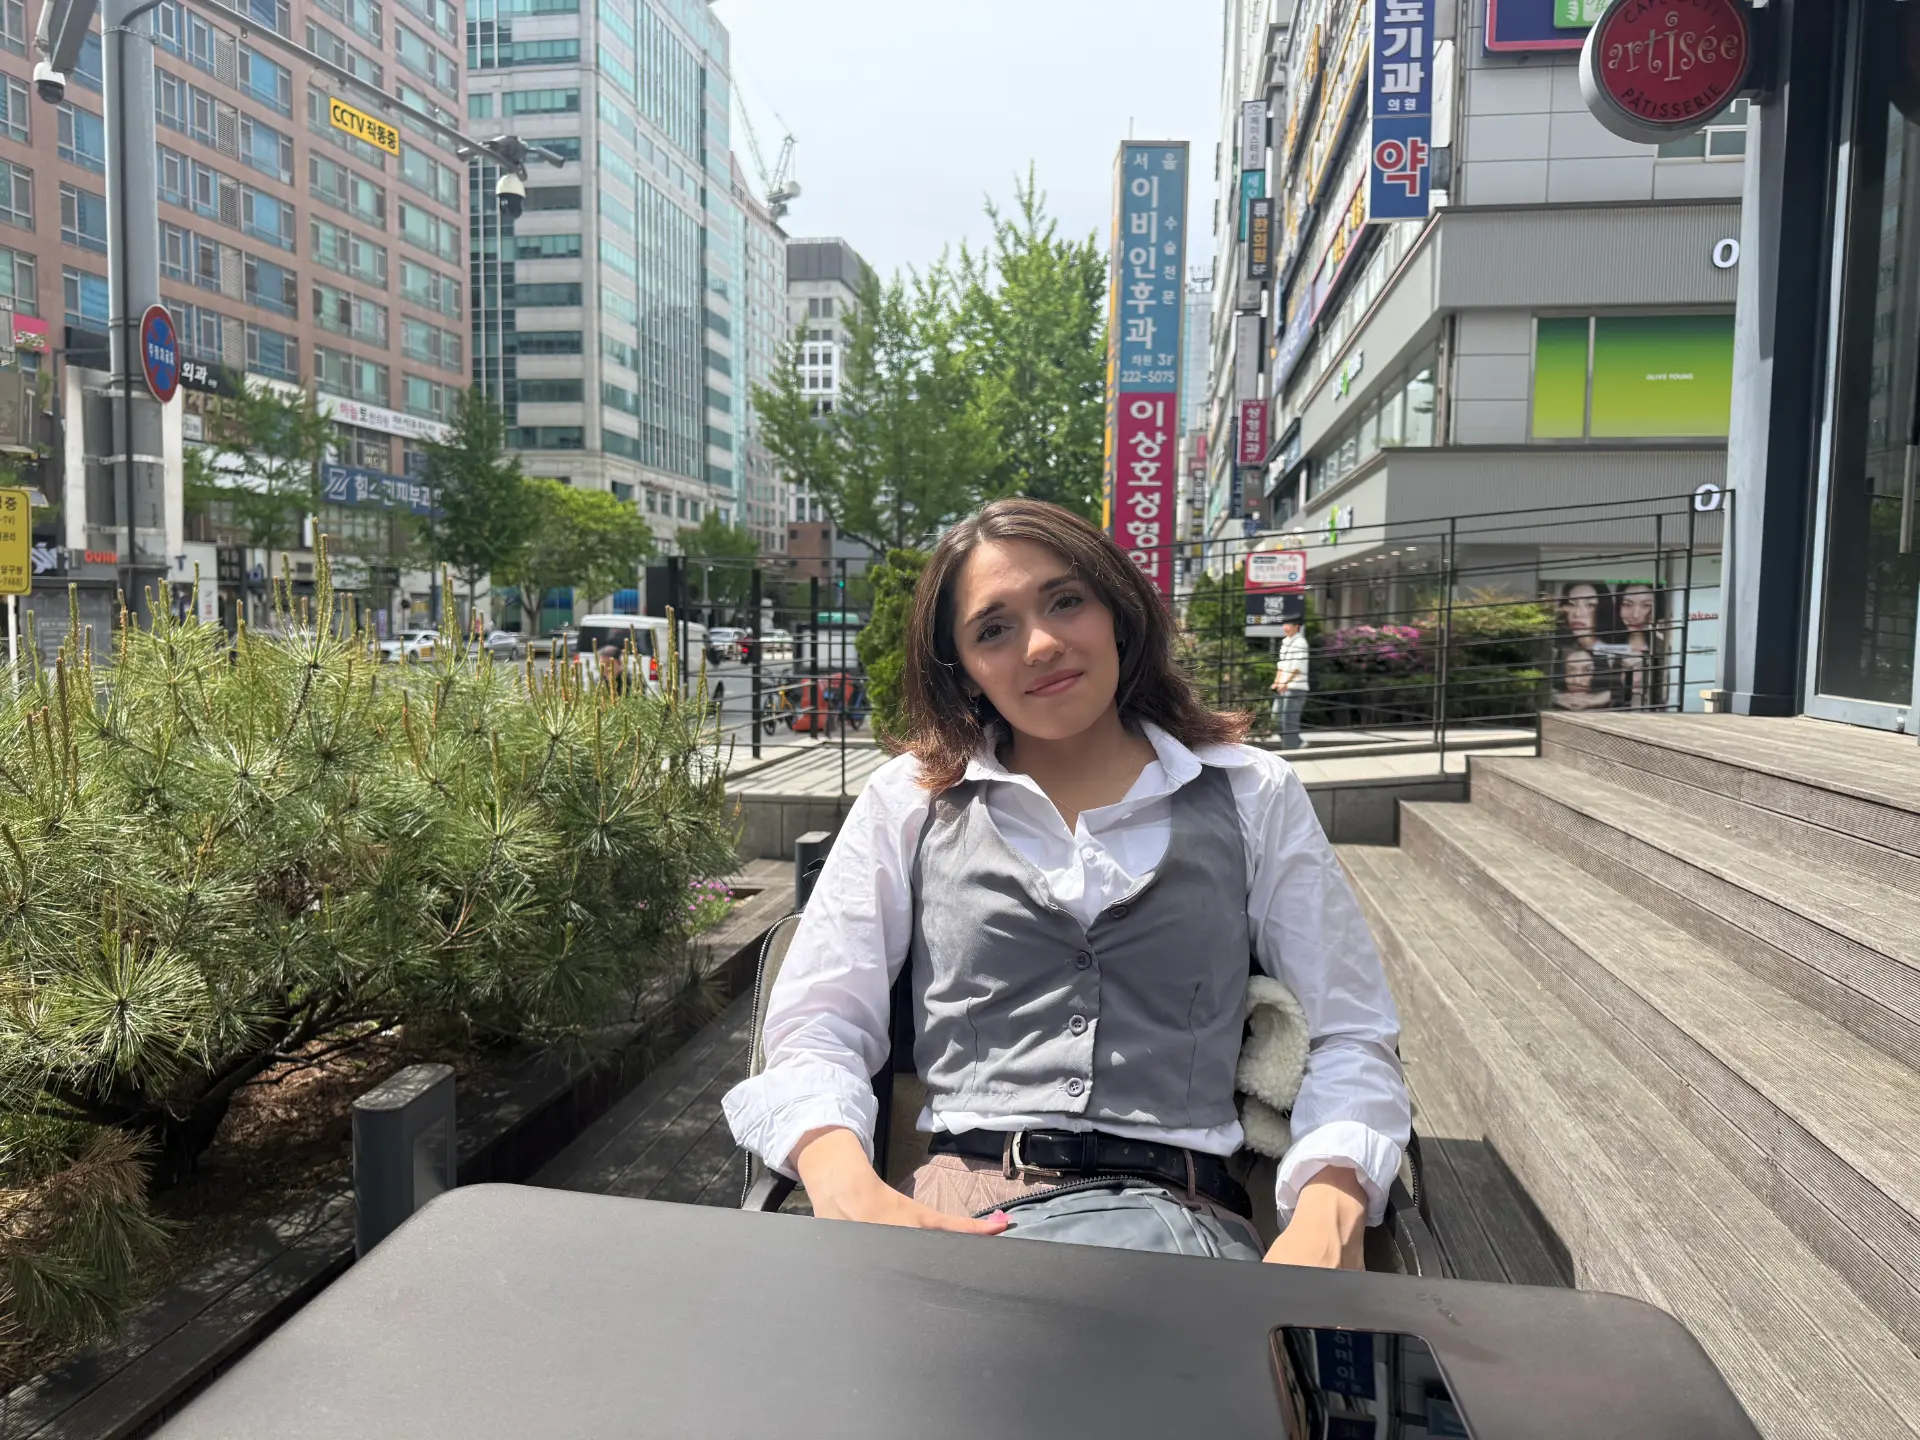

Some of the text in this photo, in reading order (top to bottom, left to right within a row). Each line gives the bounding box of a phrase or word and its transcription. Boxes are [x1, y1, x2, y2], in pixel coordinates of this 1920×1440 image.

[1608, 11, 1739, 81] artisée
[333, 105, 396, 149] CCTV 작동중
[1388, 98, 1416, 111] 의원
[1374, 137, 1428, 197] 약
[1125, 175, 1159, 350] 이비인후과
[1162, 216, 1178, 305] 수술전문
[1121, 371, 1176, 384] 222-5075
[1157, 353, 1174, 366] 3F
[1127, 400, 1167, 593] 이상호성형외
